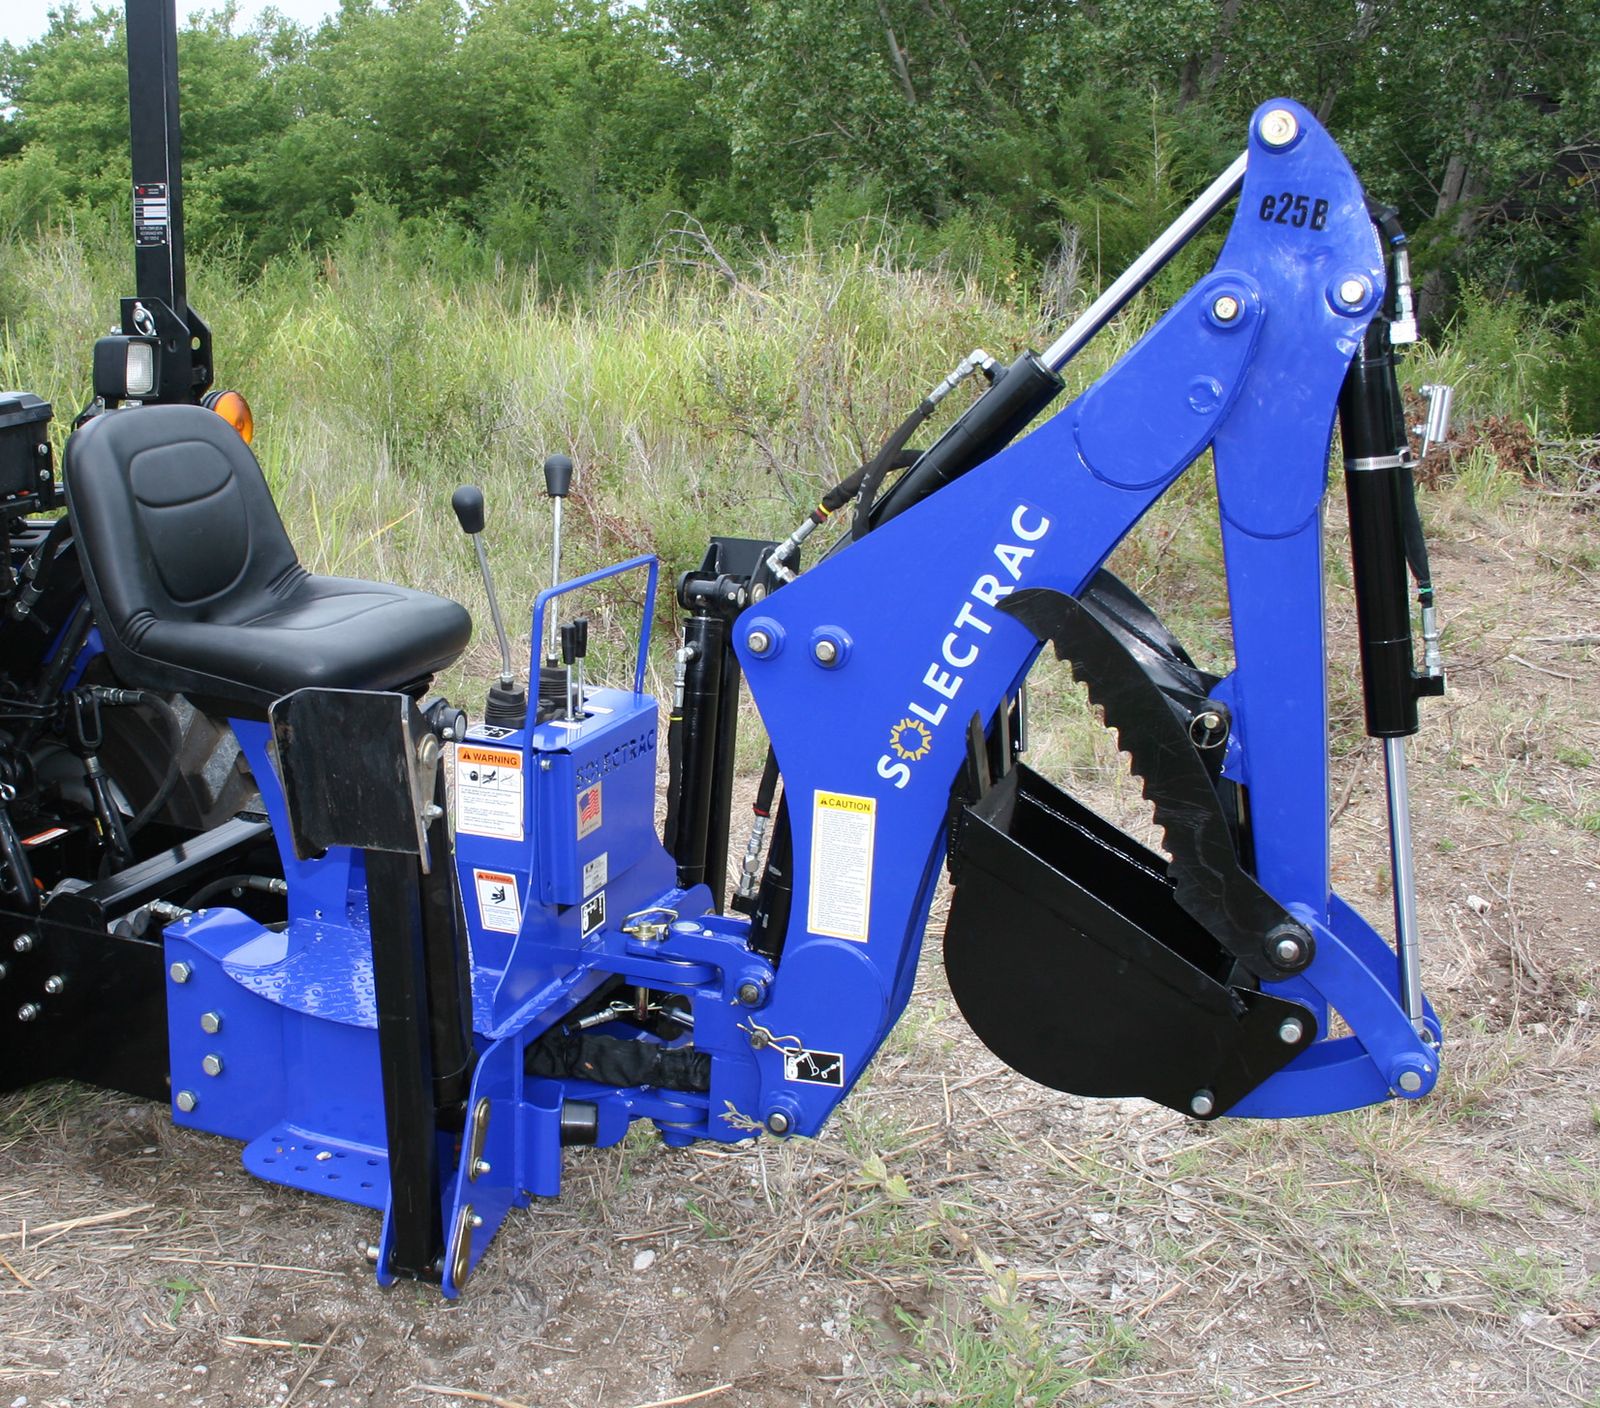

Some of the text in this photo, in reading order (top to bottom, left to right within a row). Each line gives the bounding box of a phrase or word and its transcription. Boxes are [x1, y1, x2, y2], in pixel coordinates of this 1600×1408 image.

[1259, 192, 1329, 231] e25B
[473, 753, 517, 766] WARNING
[576, 729, 655, 789] SOLECTRAC
[828, 798, 871, 811] CAUTION
